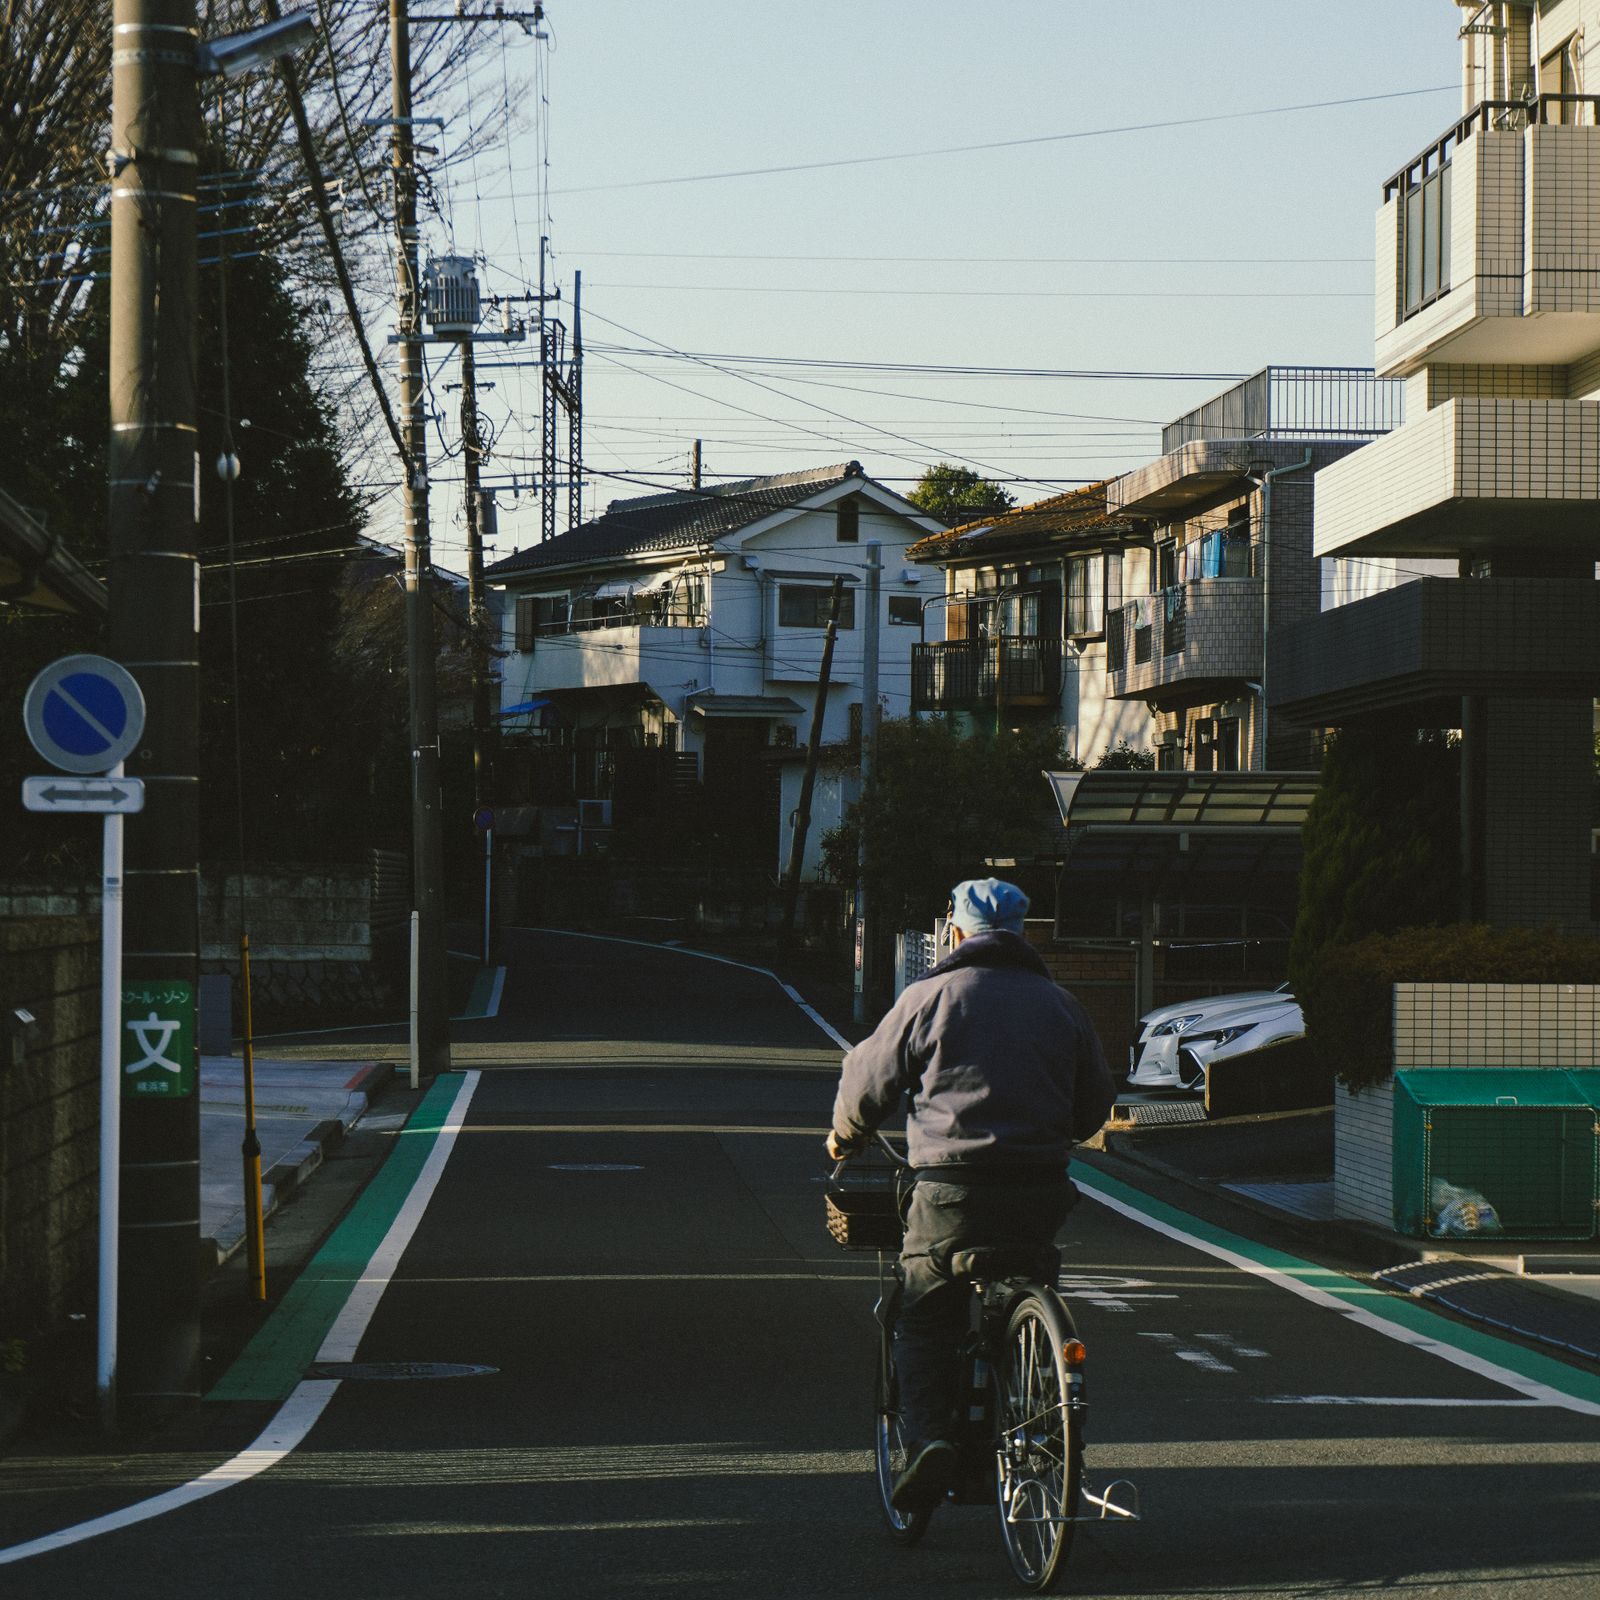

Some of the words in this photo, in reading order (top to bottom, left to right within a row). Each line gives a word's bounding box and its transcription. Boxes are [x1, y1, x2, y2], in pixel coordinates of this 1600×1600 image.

[121, 991, 189, 1004] クール・ゾーン
[126, 1011, 181, 1074] 文
